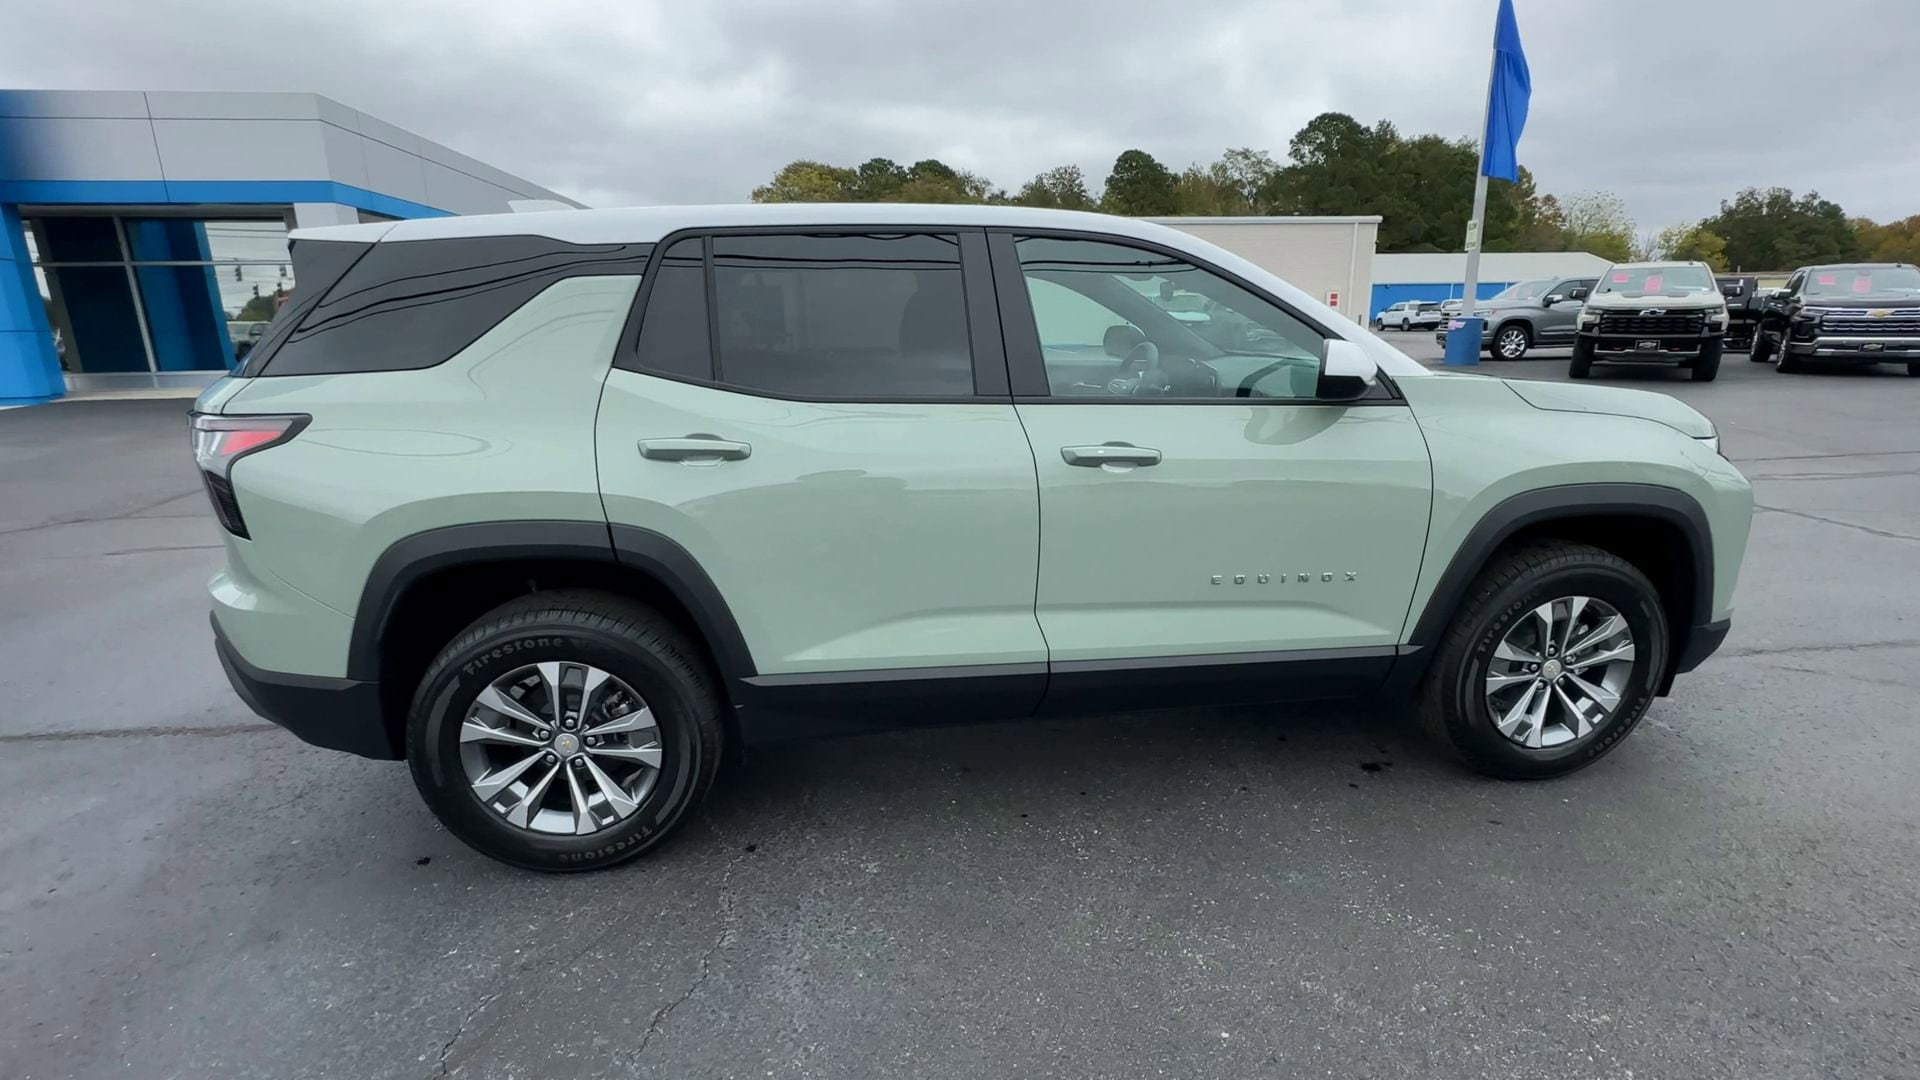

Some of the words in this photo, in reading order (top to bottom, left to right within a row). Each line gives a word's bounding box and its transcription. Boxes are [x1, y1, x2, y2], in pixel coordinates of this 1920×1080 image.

[1210, 571, 1357, 586] EQUINOX
[462, 637, 564, 676] Firestone
[559, 826, 653, 862] Firestone
